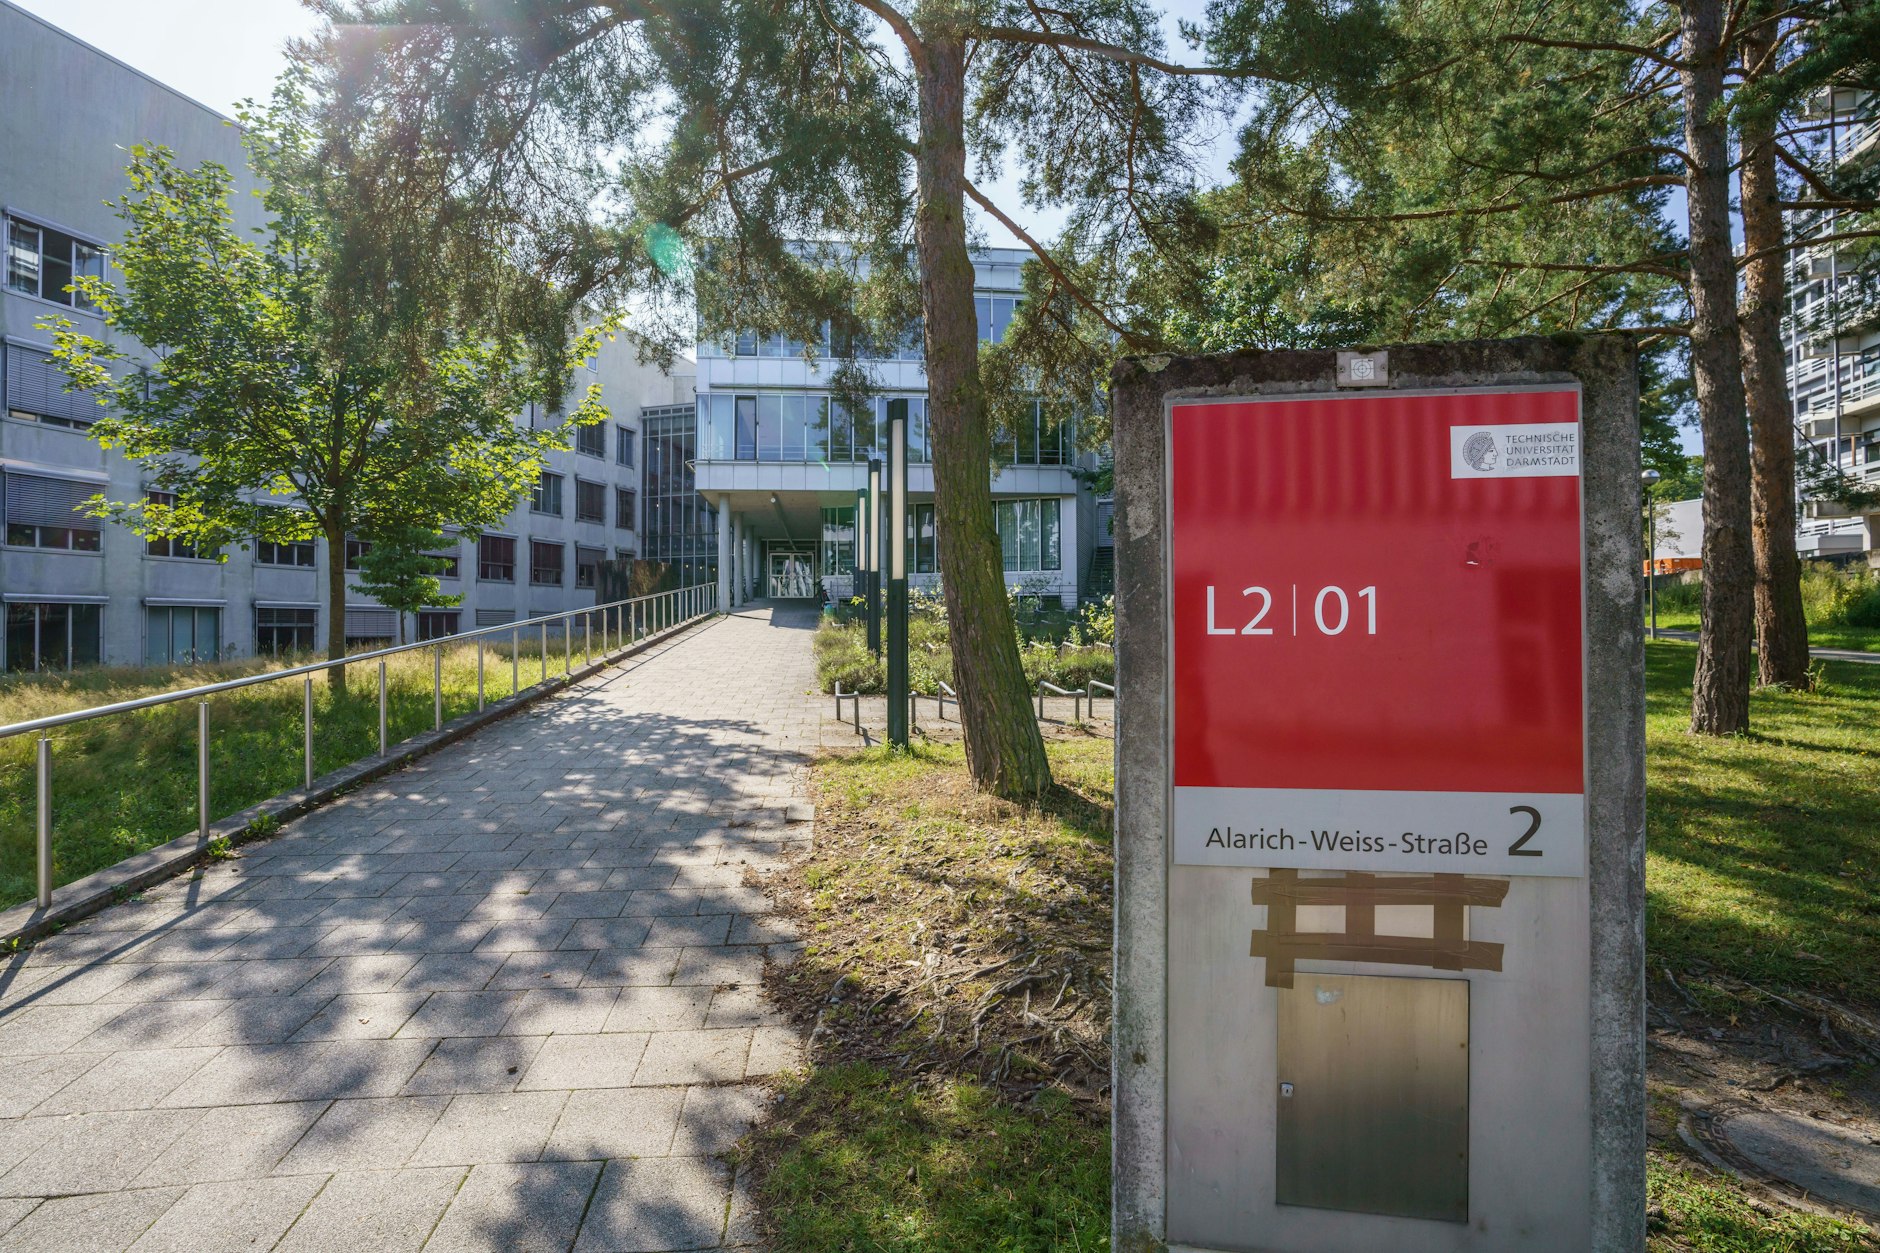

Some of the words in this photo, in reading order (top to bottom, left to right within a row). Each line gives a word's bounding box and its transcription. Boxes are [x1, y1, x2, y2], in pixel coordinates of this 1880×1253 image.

[1506, 433, 1575, 443] TECHNISCHE
[1506, 444, 1575, 455] UNIVERSITÄT
[1506, 456, 1575, 467] DARMSTADT
[1205, 827, 1488, 856] Alarich-Weiss-Straße
[1508, 805, 1543, 857] 2
